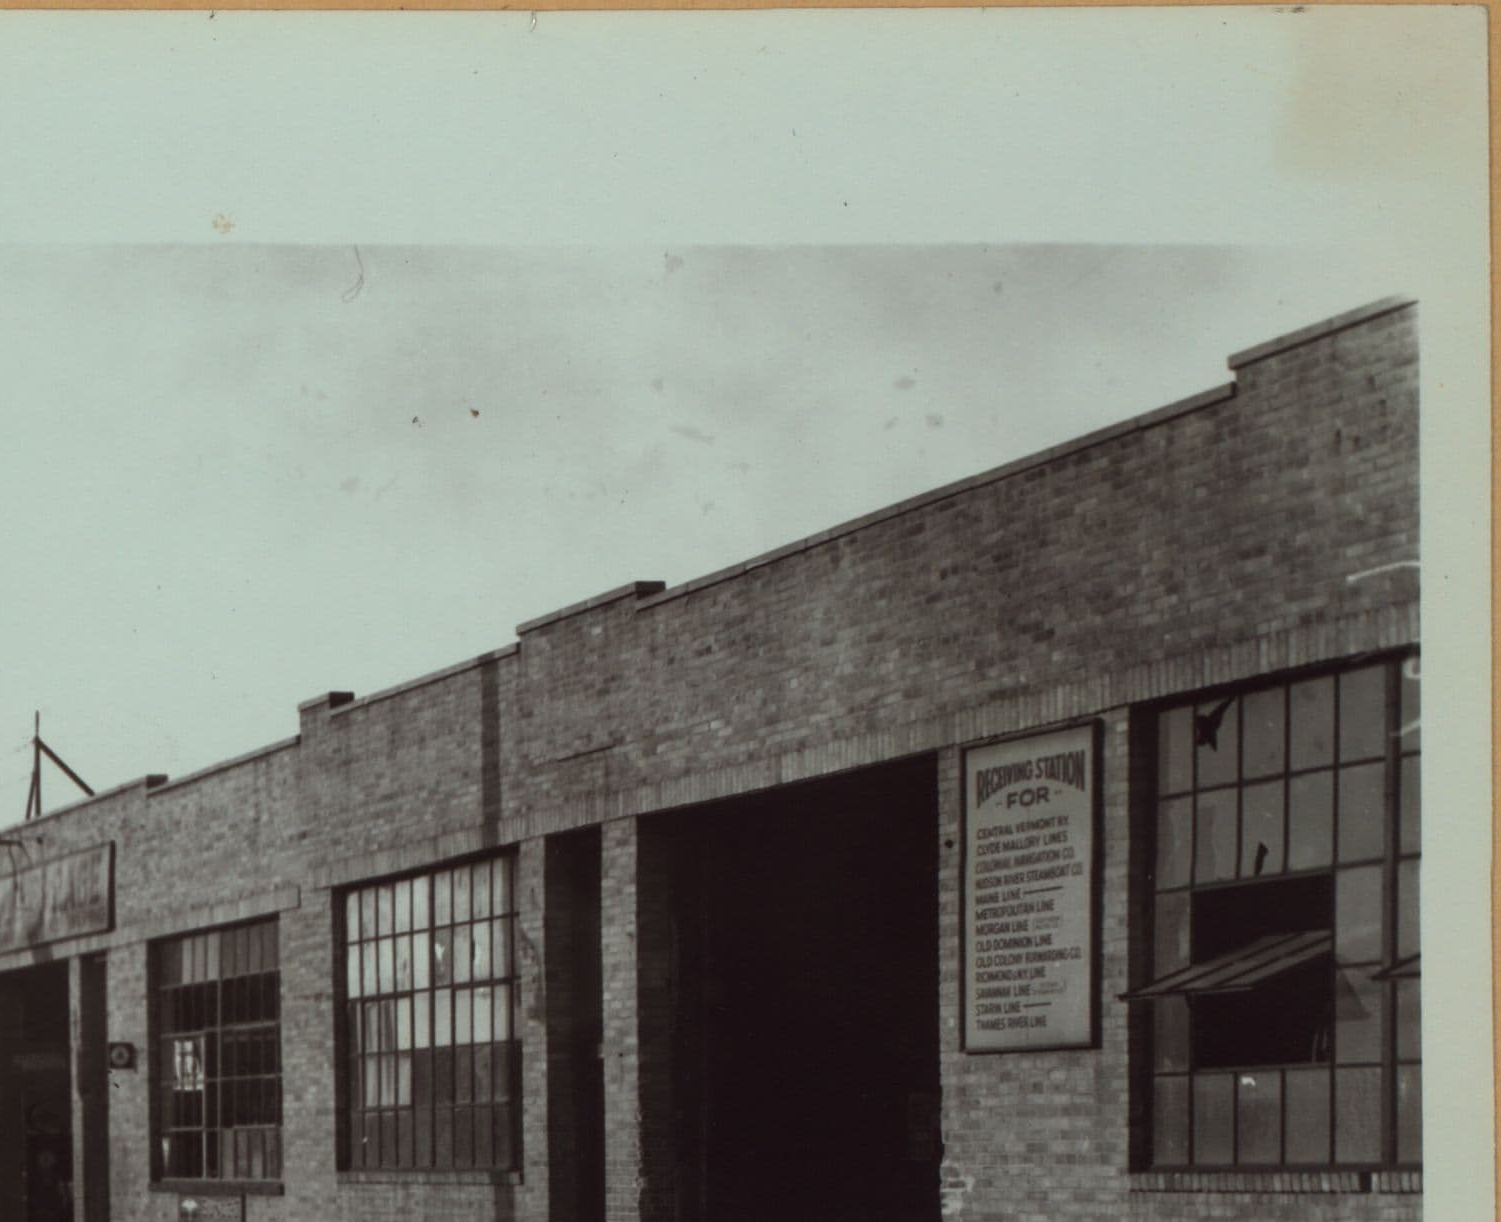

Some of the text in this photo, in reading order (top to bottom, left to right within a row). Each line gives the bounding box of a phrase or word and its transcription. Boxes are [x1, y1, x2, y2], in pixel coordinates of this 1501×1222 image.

[976, 749, 1086, 809] RECEIVING STATION
[1006, 786, 1050, 809] FOR
[977, 824, 1013, 840] CENTRAL
[1015, 816, 1056, 833] VERMONT
[977, 831, 1069, 857] CLYDE MALLORY LINES
[976, 857, 1012, 875] COLONIAL
[1013, 850, 1062, 867] NAVIGATION
[976, 875, 1003, 890] HUDSON
[1004, 871, 1025, 886] RIVER
[1025, 864, 1070, 881] STEAMBOAT
[976, 888, 1021, 906] MAINE LINE
[976, 899, 1054, 920] METROPOLITAN LINE
[976, 921, 1011, 936] MORGAN
[1011, 919, 1029, 933] LINE
[976, 933, 1052, 953] OLD DOMINION LINE
[976, 955, 993, 969] OLD
[993, 952, 1024, 967] COLONY
[1029, 966, 1046, 980] LINE
[976, 985, 1011, 1000] SAVANNAH
[1013, 983, 1031, 997] LINE
[1004, 1001, 1021, 1014] LINE
[976, 1014, 1047, 1031] THAMES RIVER LINE
